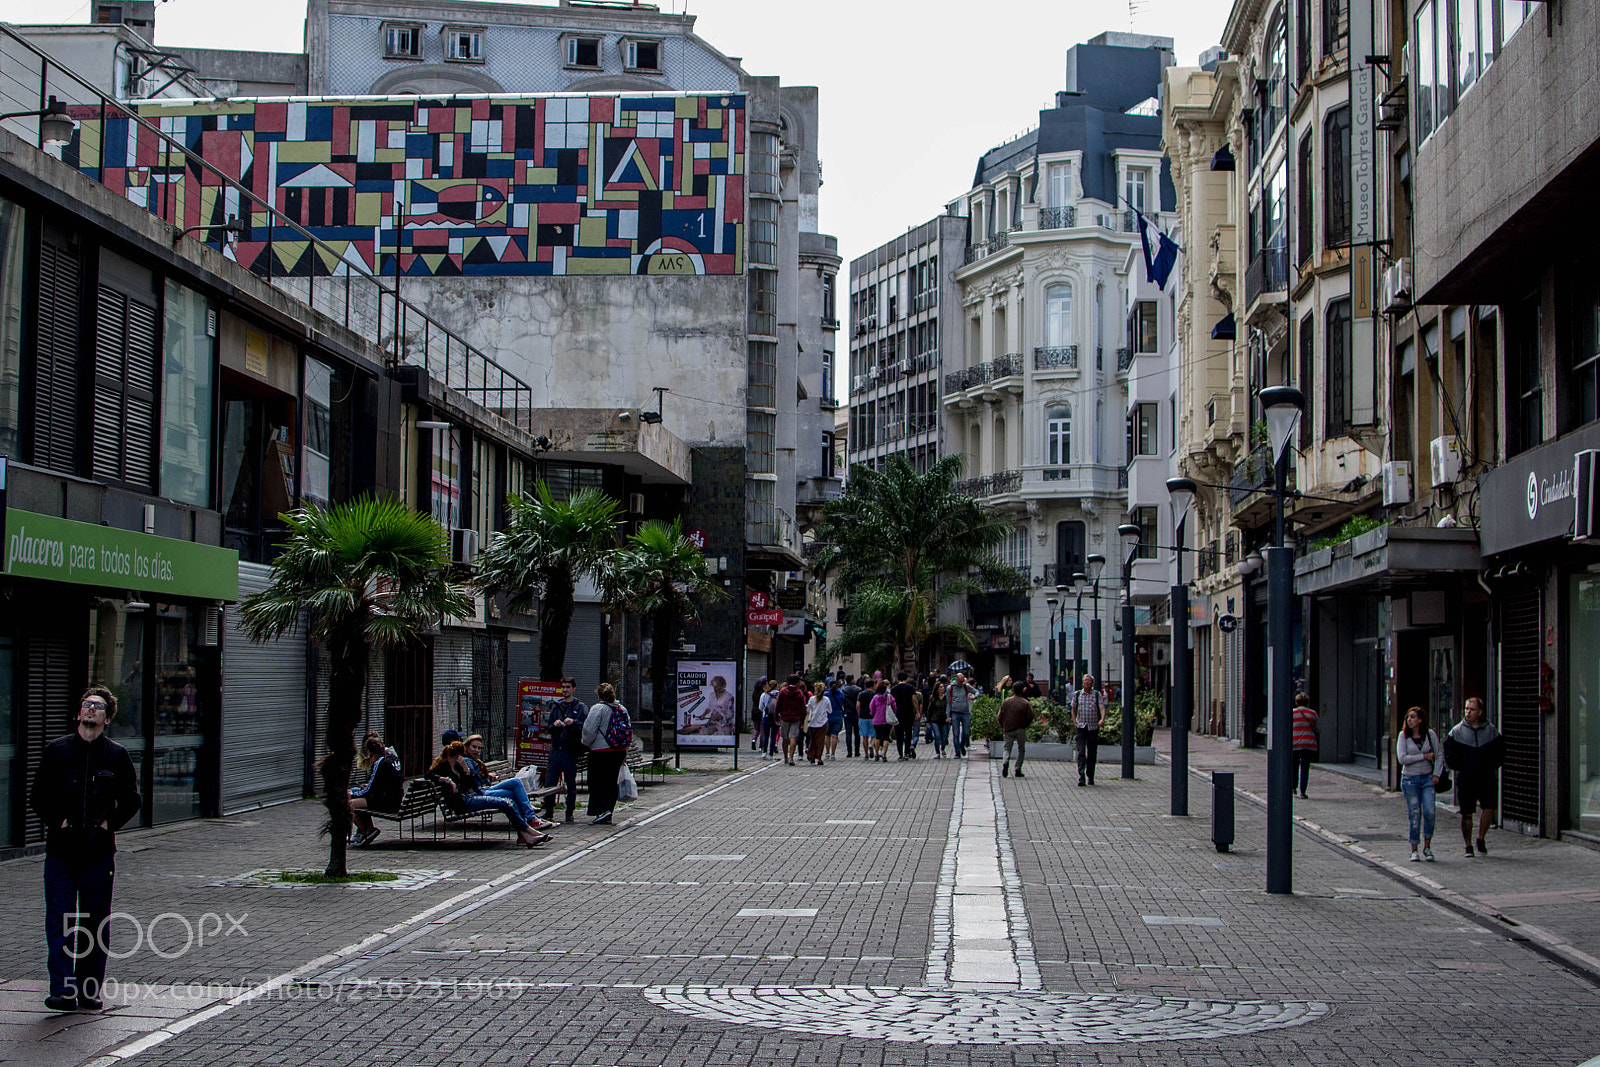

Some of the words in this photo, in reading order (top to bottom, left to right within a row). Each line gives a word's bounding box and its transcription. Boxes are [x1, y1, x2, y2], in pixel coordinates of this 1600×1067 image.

[1357, 72, 1369, 125] García
[1356, 129, 1369, 182] Torres
[697, 213, 706, 237] 1
[1357, 182, 1369, 237] Museo
[7, 525, 64, 574] placeres
[69, 544, 96, 575] para
[101, 544, 131, 576] todos
[133, 547, 149, 579] los
[151, 551, 174, 581] días.
